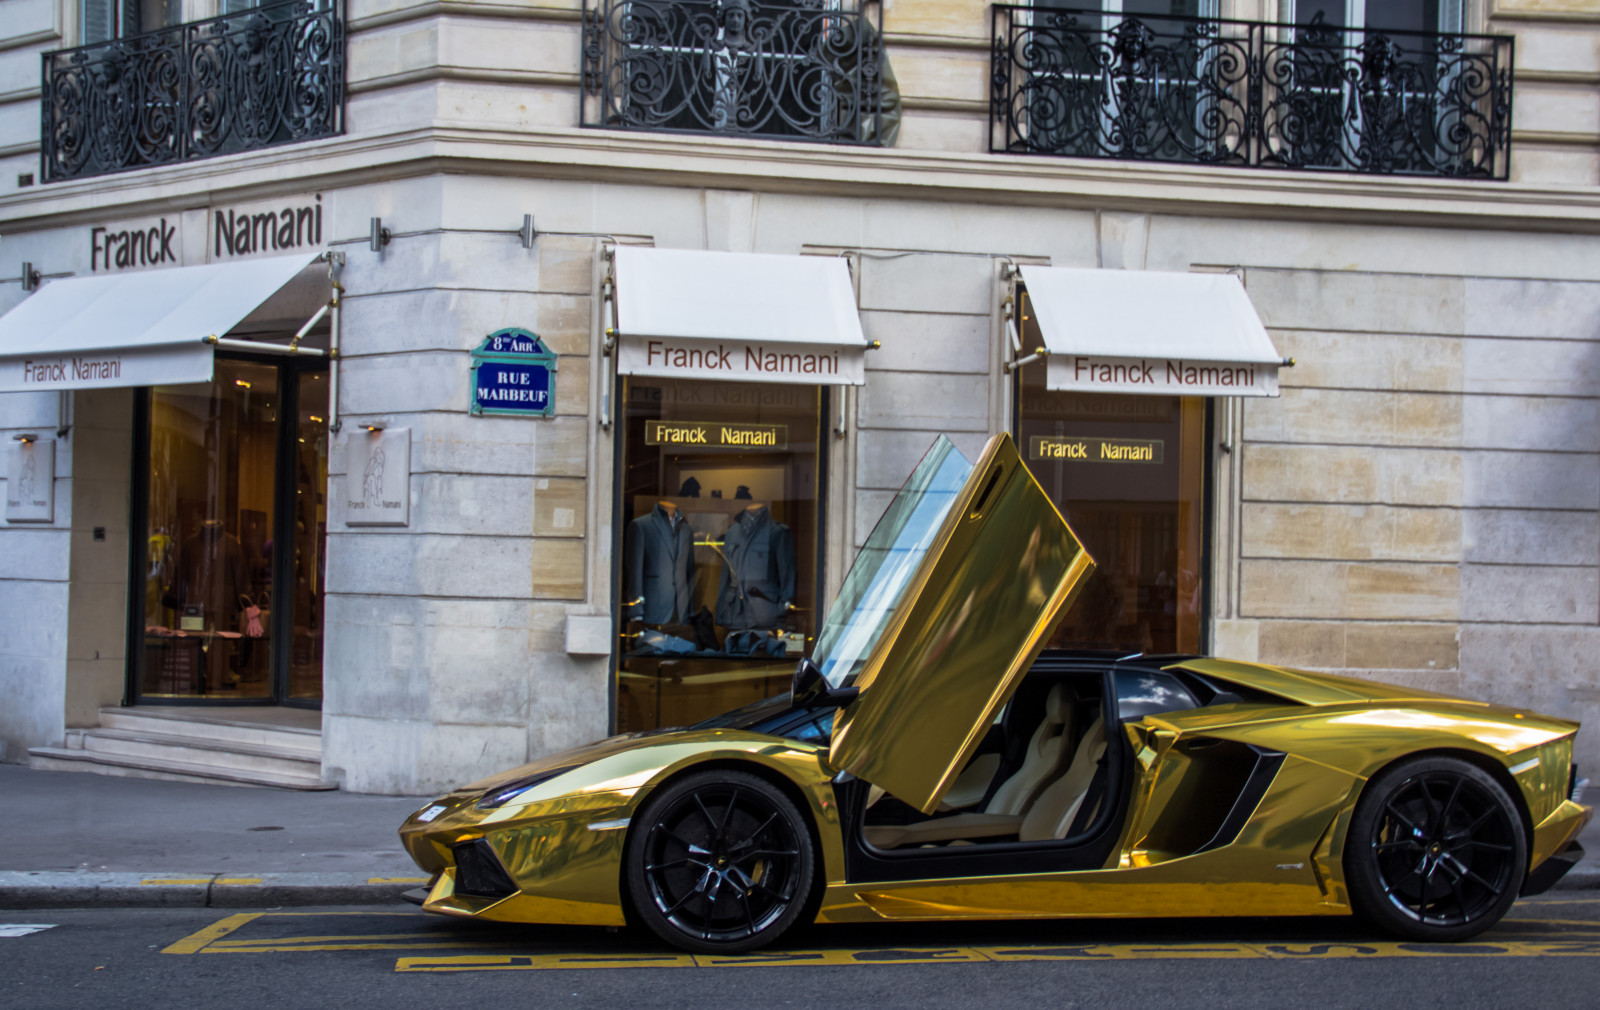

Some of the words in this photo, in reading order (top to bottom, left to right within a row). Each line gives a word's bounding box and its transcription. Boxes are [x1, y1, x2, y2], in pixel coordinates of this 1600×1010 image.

[91, 218, 176, 272] Franck
[215, 193, 323, 258] Namani
[24, 359, 66, 382] Franck
[72, 355, 122, 381] Namani
[647, 340, 732, 370] Franck
[745, 345, 839, 374] Namani
[497, 371, 530, 385] RUE
[1074, 357, 1154, 384] Franck
[1166, 360, 1254, 387] Namani
[477, 387, 548, 403] MARBEUF
[656, 425, 707, 444] Franck
[720, 426, 776, 446] Namani
[1039, 440, 1088, 459] Franck
[1100, 442, 1153, 461] Namani
